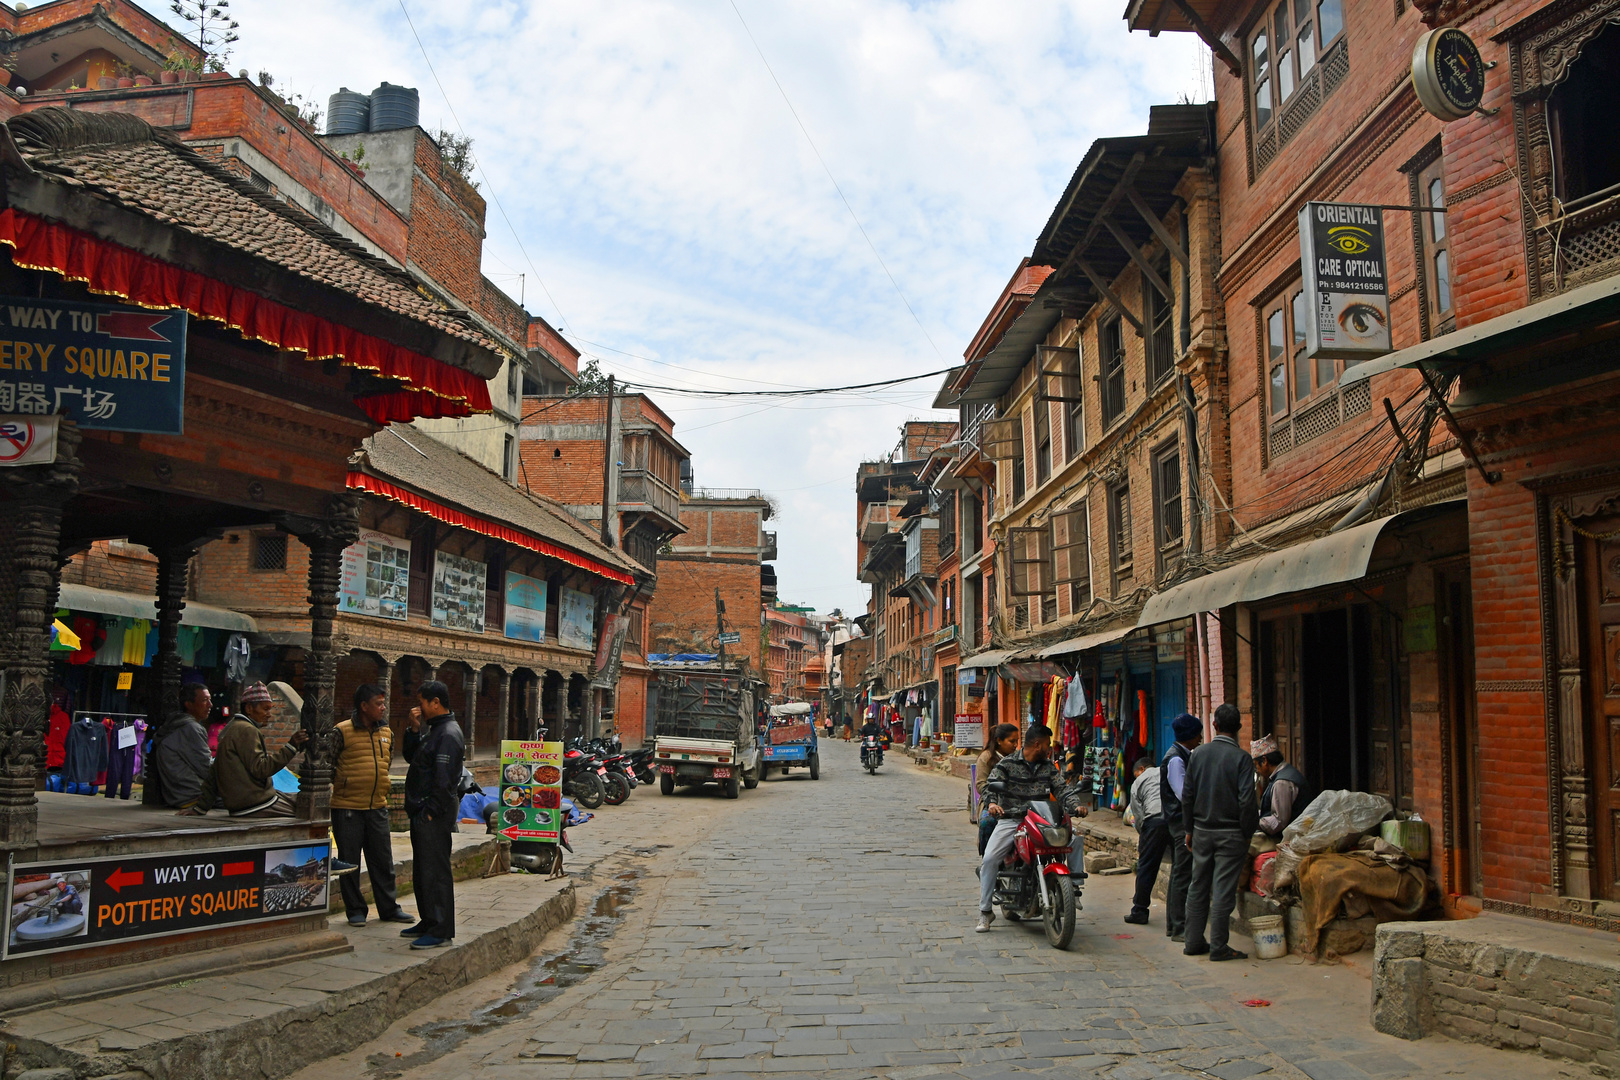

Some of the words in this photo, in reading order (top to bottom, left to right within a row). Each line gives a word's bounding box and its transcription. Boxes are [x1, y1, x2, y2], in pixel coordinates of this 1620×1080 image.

[1317, 205, 1378, 225] ORIENTAL
[1318, 258, 1342, 276] CARE
[1345, 259, 1382, 278] OPTICAL
[1321, 292, 1331, 305] E
[9, 305, 63, 331] WAY
[69, 311, 93, 333] TO
[64, 345, 171, 383] SQUARE
[601, 625, 613, 660] COSY
[606, 638, 621, 683] HOTEL
[520, 743, 544, 751] कृष्ण
[531, 752, 559, 760] सेन्टर
[154, 865, 191, 885] WAY
[194, 863, 216, 881] TO
[97, 895, 187, 928] POTTERY
[190, 887, 260, 917] SQAURE
